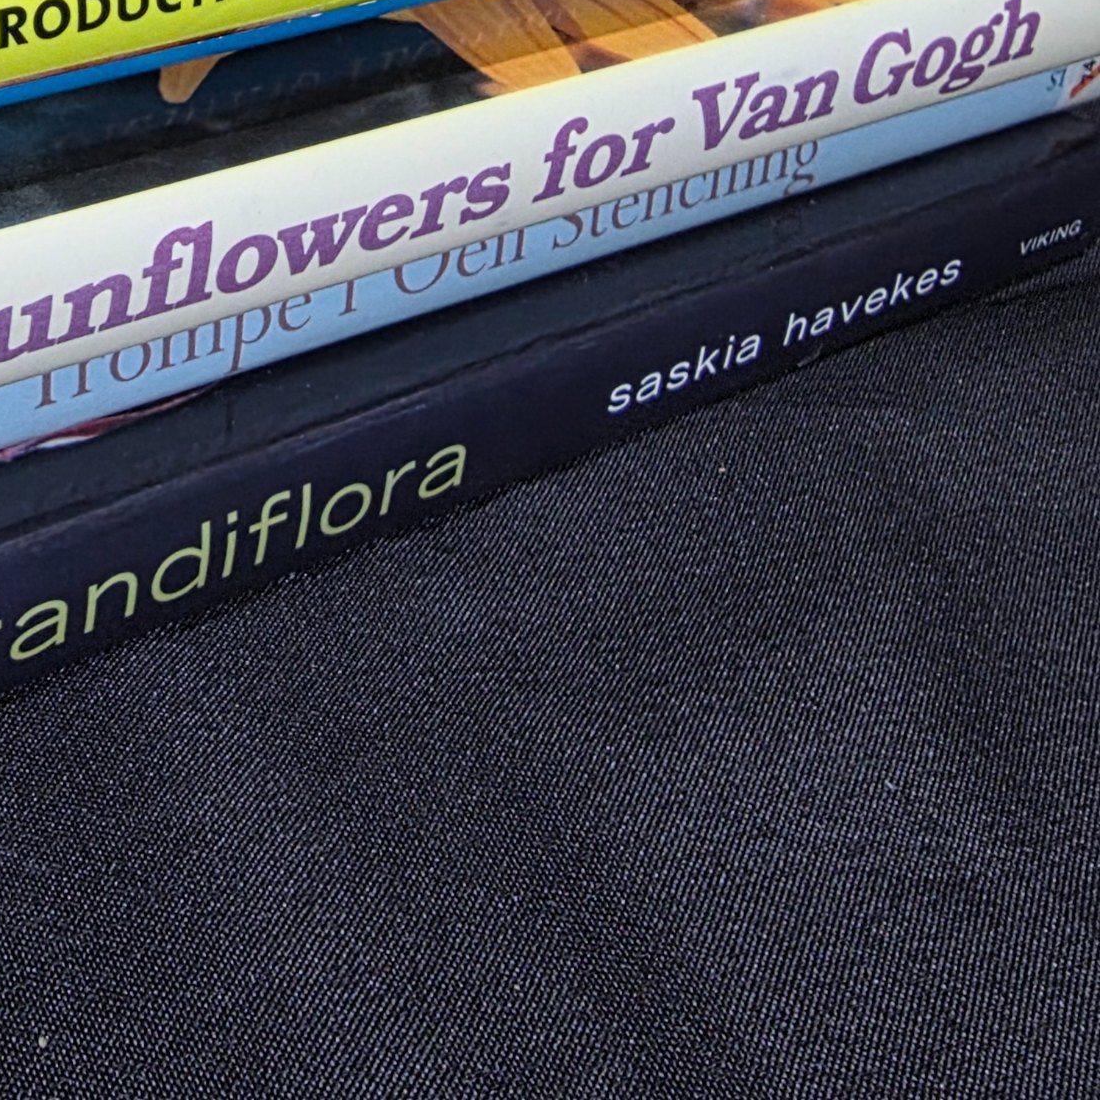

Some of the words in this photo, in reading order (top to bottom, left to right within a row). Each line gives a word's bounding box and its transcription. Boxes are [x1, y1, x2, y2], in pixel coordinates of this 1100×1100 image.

[532, 117, 675, 204] for
[691, 72, 848, 151] Van
[606, 331, 761, 414] saskia
[782, 257, 963, 349] havekes
[1020, 219, 1082, 256] VIKING
